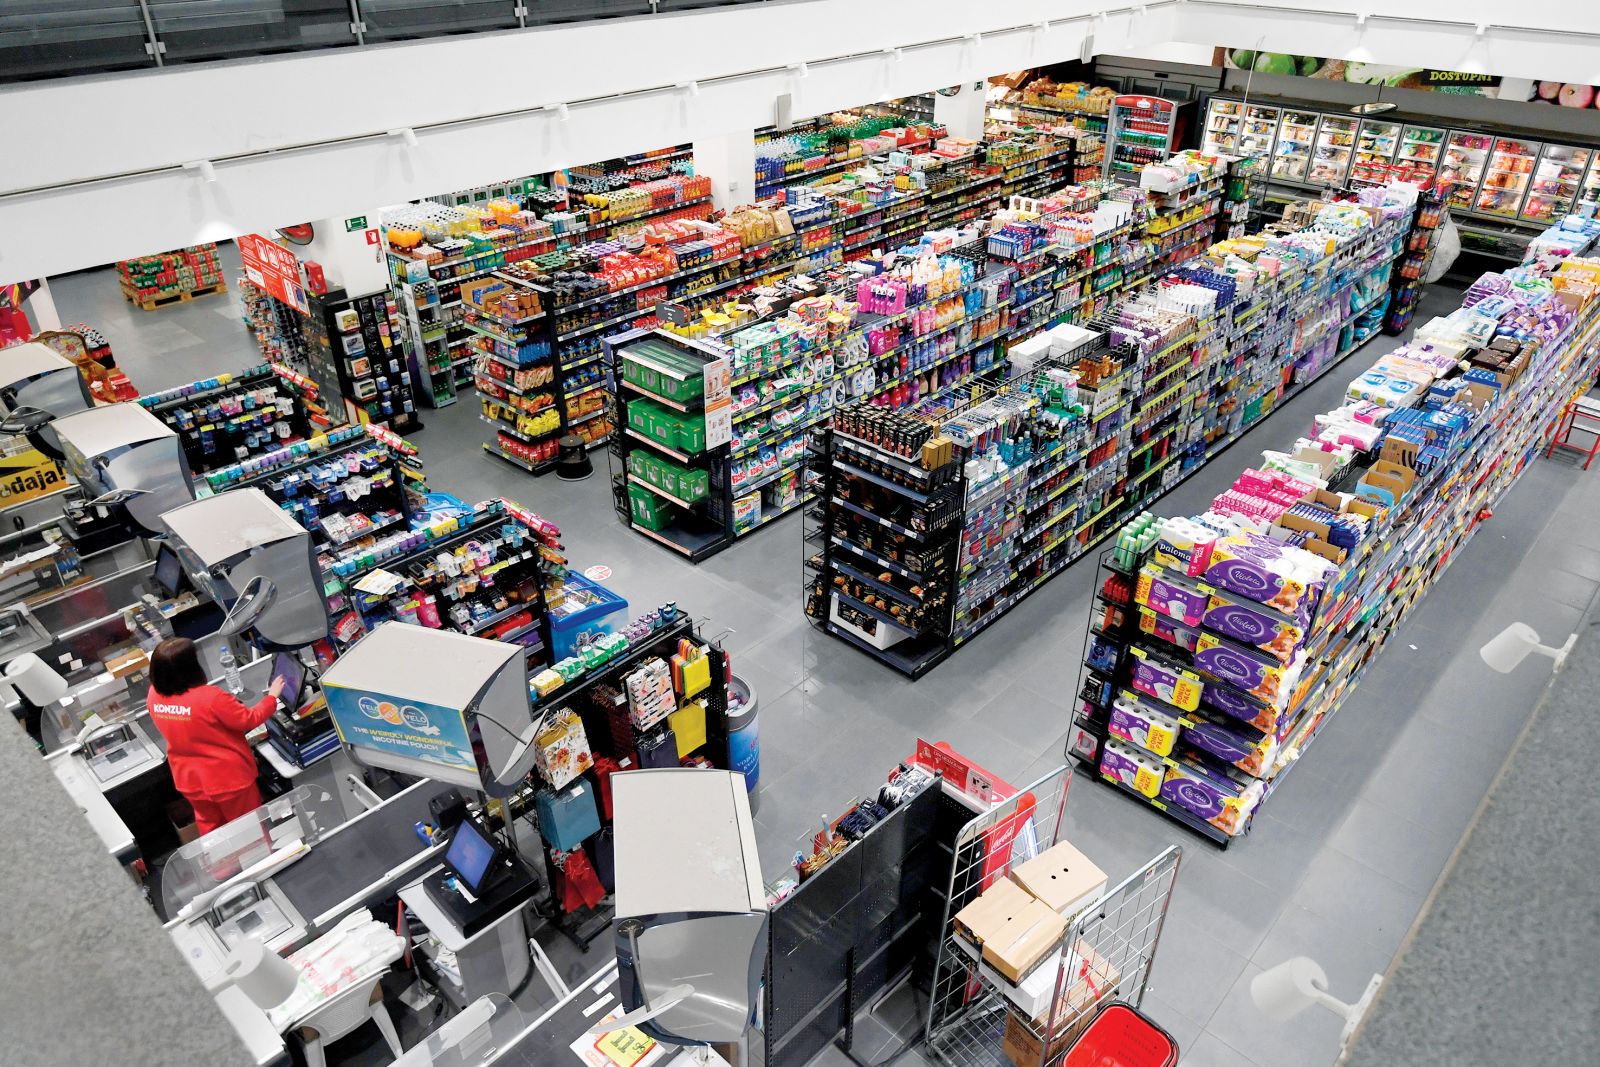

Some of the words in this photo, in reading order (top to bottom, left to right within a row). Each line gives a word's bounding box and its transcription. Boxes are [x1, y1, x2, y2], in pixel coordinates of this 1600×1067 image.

[1159, 543, 1192, 562] paloma
[1234, 570, 1261, 586] Violeta
[1232, 616, 1257, 632] Violeta
[1219, 658, 1244, 675] Violeta
[1175, 683, 1187, 705] BONUS
[1183, 687, 1192, 705] PACK
[153, 703, 192, 717] KONZUM
[352, 726, 369, 735] THE
[369, 728, 404, 740] WEIRDLY
[404, 734, 456, 748] WONDERFUL
[372, 735, 410, 748] NICOTINE
[410, 741, 439, 752] POUCH
[1156, 733, 1165, 749] PACK
[610, 1030, 636, 1054] 11
